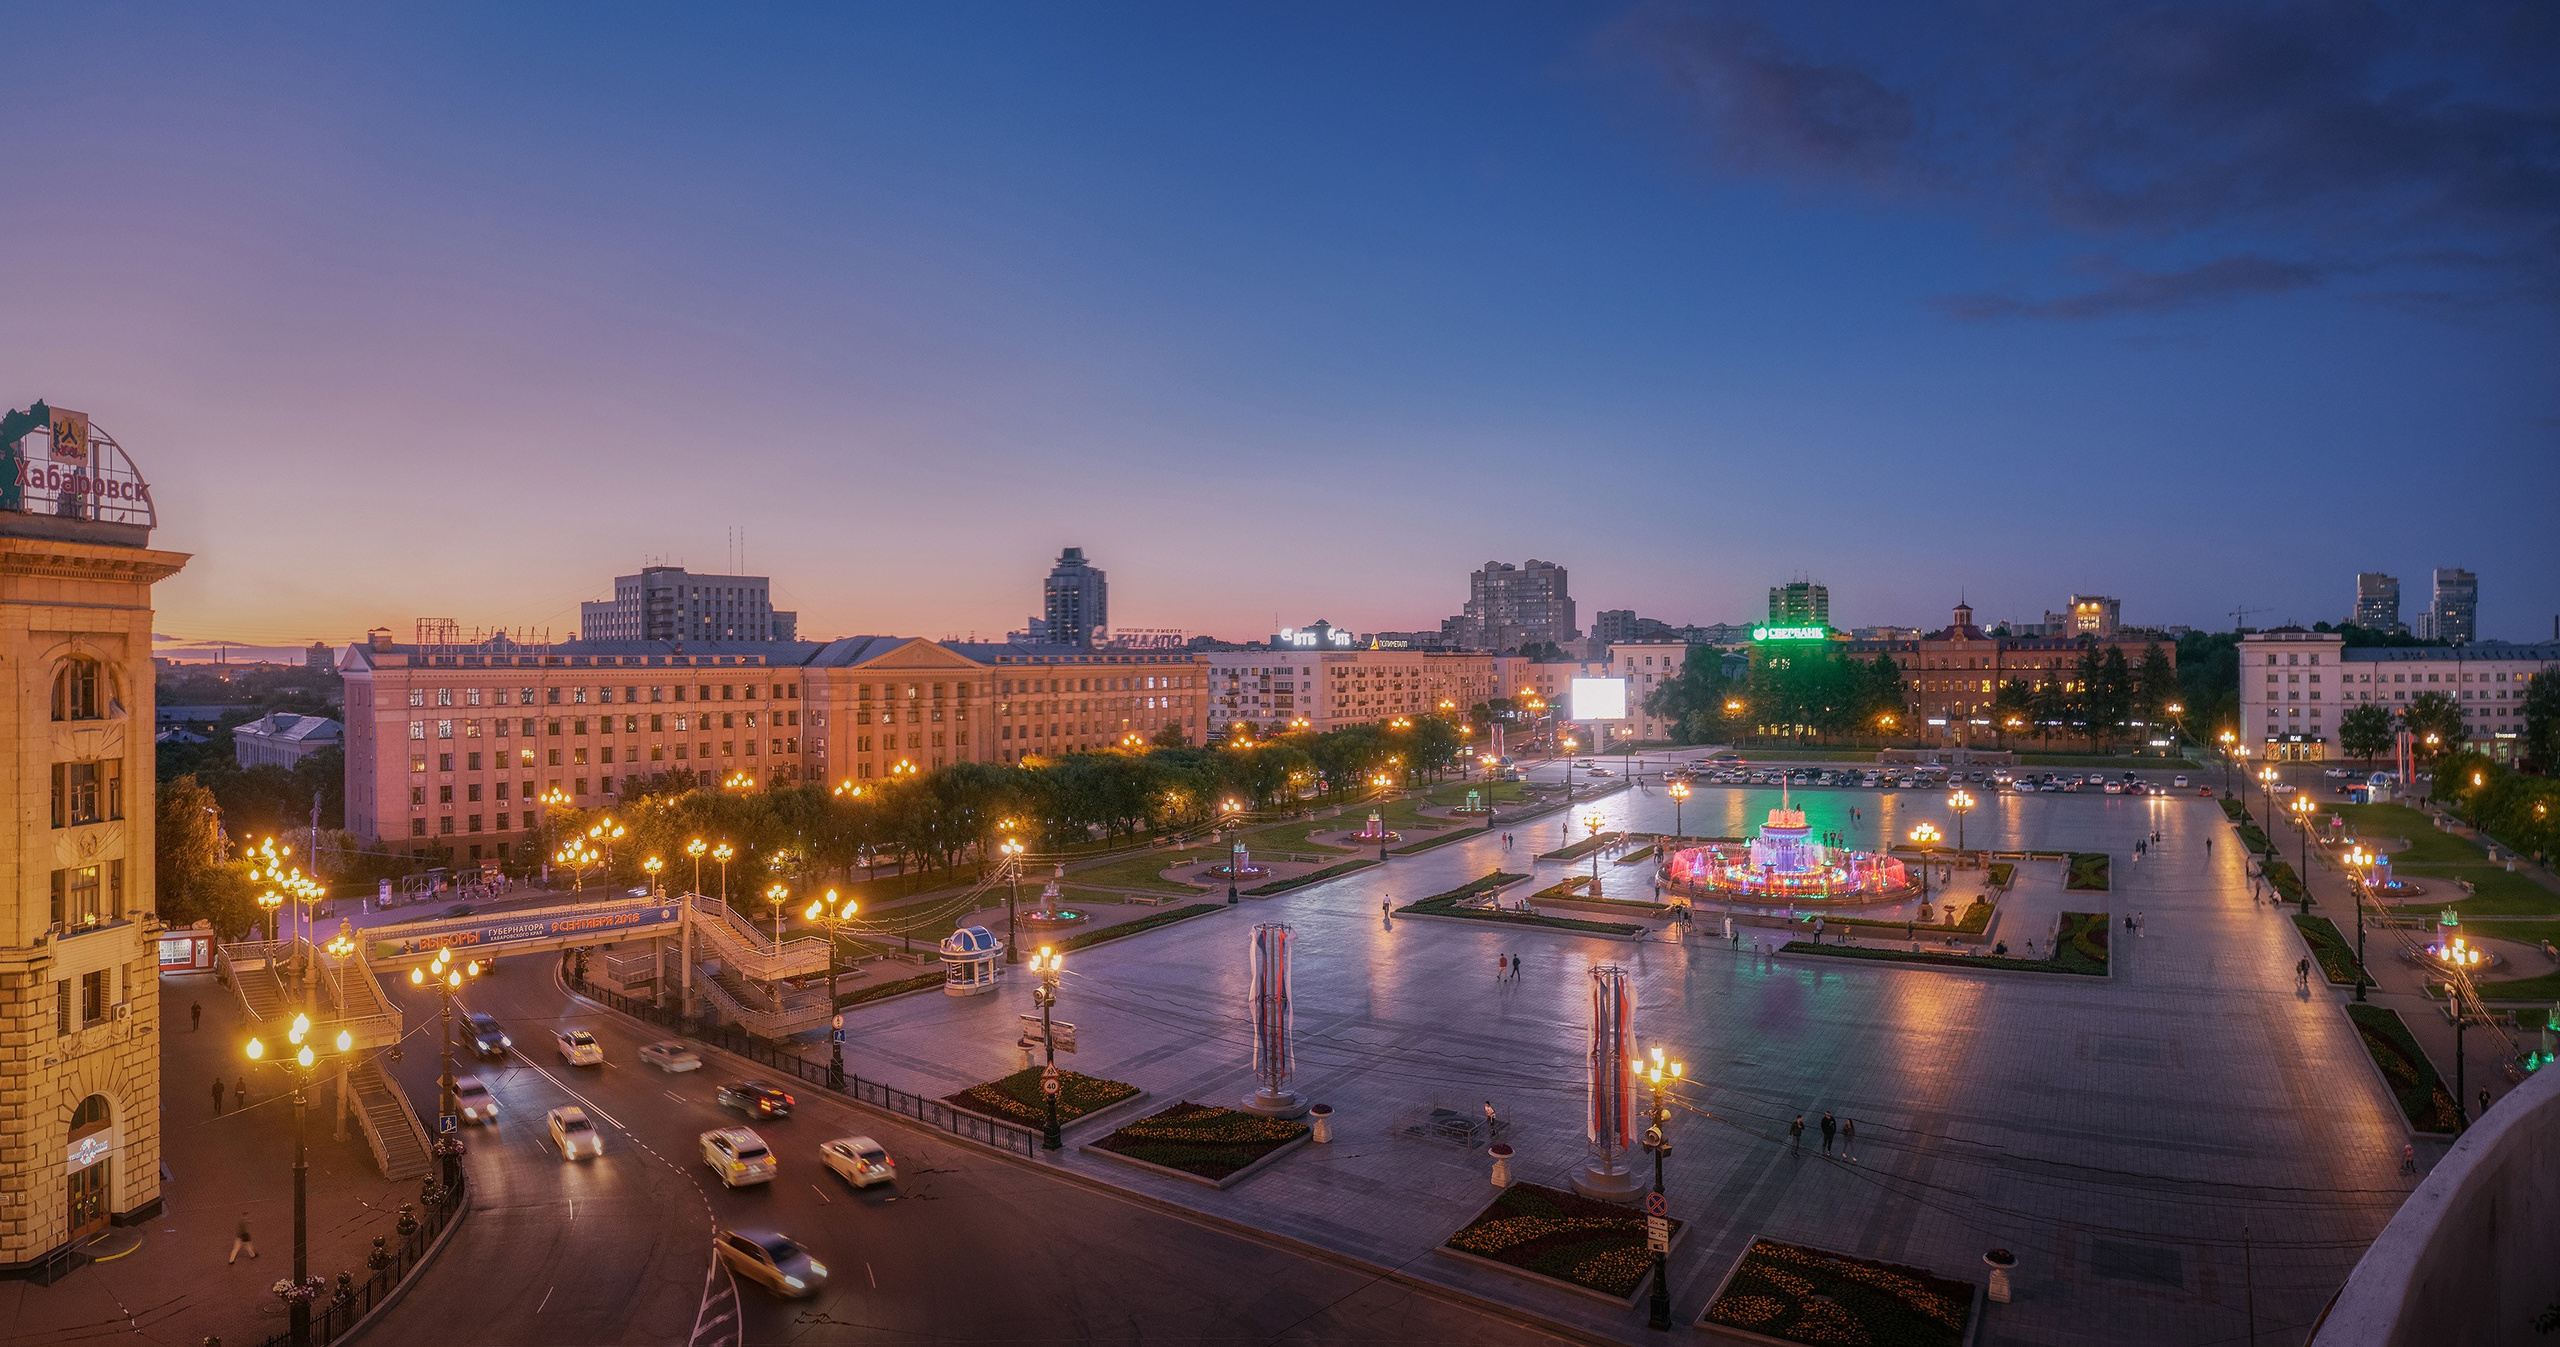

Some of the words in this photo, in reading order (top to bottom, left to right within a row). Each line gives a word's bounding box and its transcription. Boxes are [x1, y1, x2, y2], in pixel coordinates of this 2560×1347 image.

[14, 458, 151, 502] Хабаровск
[1293, 632, 1317, 645] ВТБ
[1335, 632, 1350, 645] ВТБ
[1768, 628, 1824, 639] СБЕРБАНК
[1112, 634, 1183, 649] КНААПО
[551, 922, 559, 934] 9
[560, 915, 614, 932] СЕНТЯБРЯ
[614, 912, 640, 926] 2018
[488, 923, 545, 937] ГУБЕРНАТОРА
[490, 931, 529, 941] ХАБАРОВСКОГО
[419, 930, 480, 951] ВЫБОРЫ
[1047, 1082, 1056, 1090] 40
